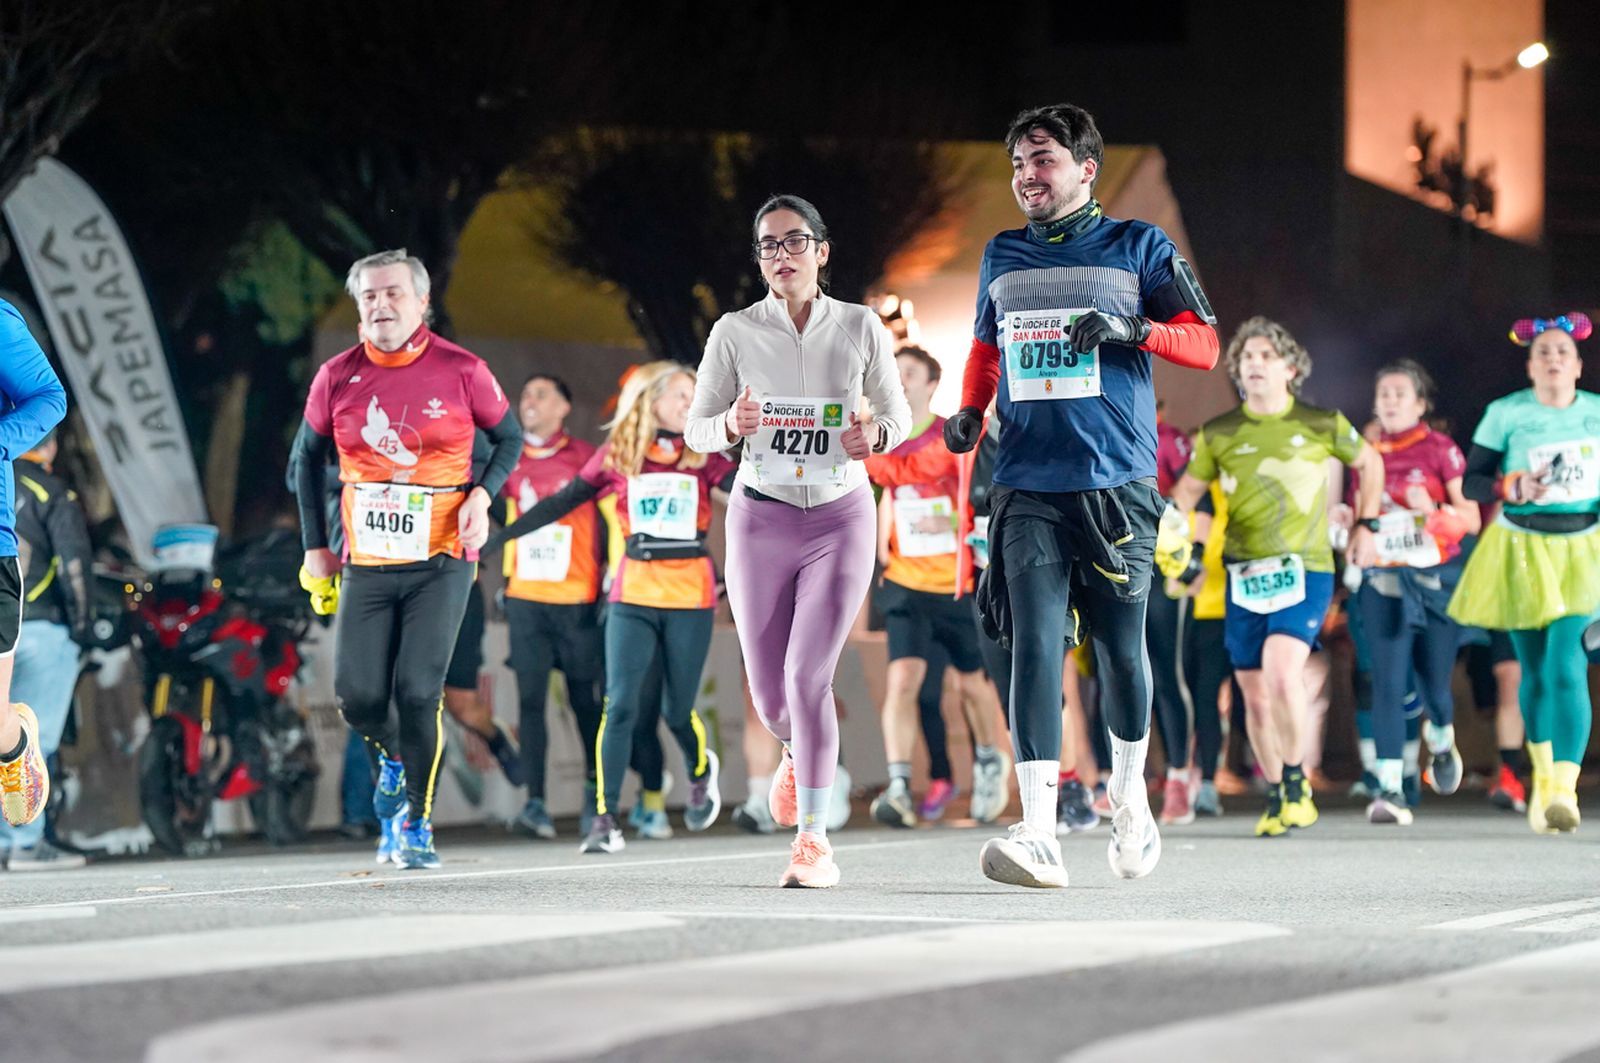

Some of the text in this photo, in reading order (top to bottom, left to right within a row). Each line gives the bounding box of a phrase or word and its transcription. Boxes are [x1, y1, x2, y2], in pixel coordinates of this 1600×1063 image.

[73, 214, 181, 452] JAPEMASA
[1022, 319, 1049, 329] NOCHE
[1050, 319, 1061, 328] DE
[1013, 331, 1029, 342] SAN
[1020, 341, 1079, 369] 8793
[774, 406, 803, 416] NOCHE
[804, 407, 815, 416] DE
[762, 417, 781, 427] SAN
[783, 416, 815, 428] ANTÓN
[378, 435, 399, 455] 43
[770, 429, 829, 455] 4270
[1243, 570, 1295, 595] 13535
